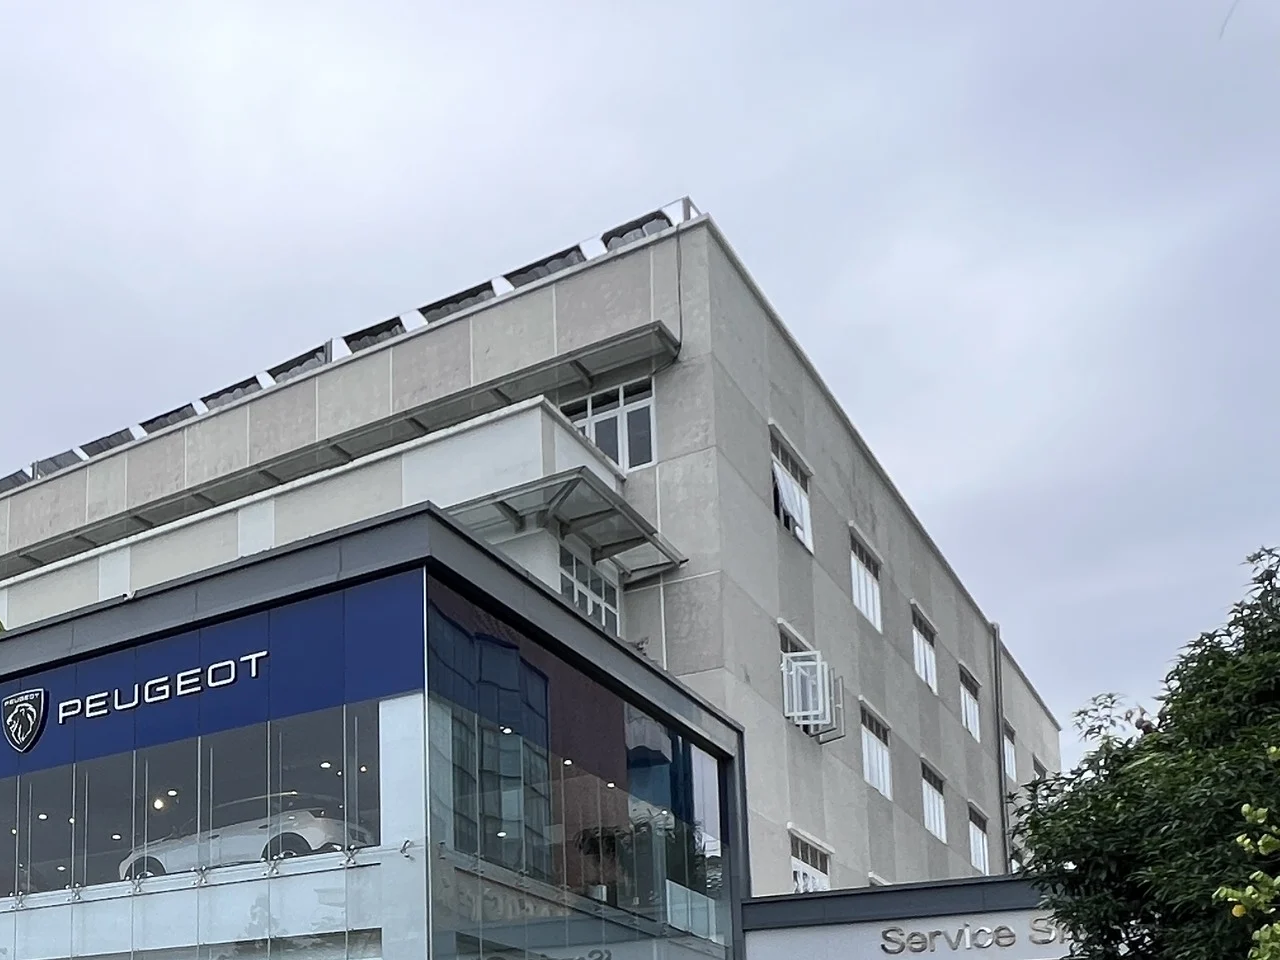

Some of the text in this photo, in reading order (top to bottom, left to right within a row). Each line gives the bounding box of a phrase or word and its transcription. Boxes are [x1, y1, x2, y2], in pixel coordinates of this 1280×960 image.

[4, 692, 40, 707] PEUGEOT
[58, 650, 268, 724] PEUGEOT
[881, 921, 1016, 955] Service
